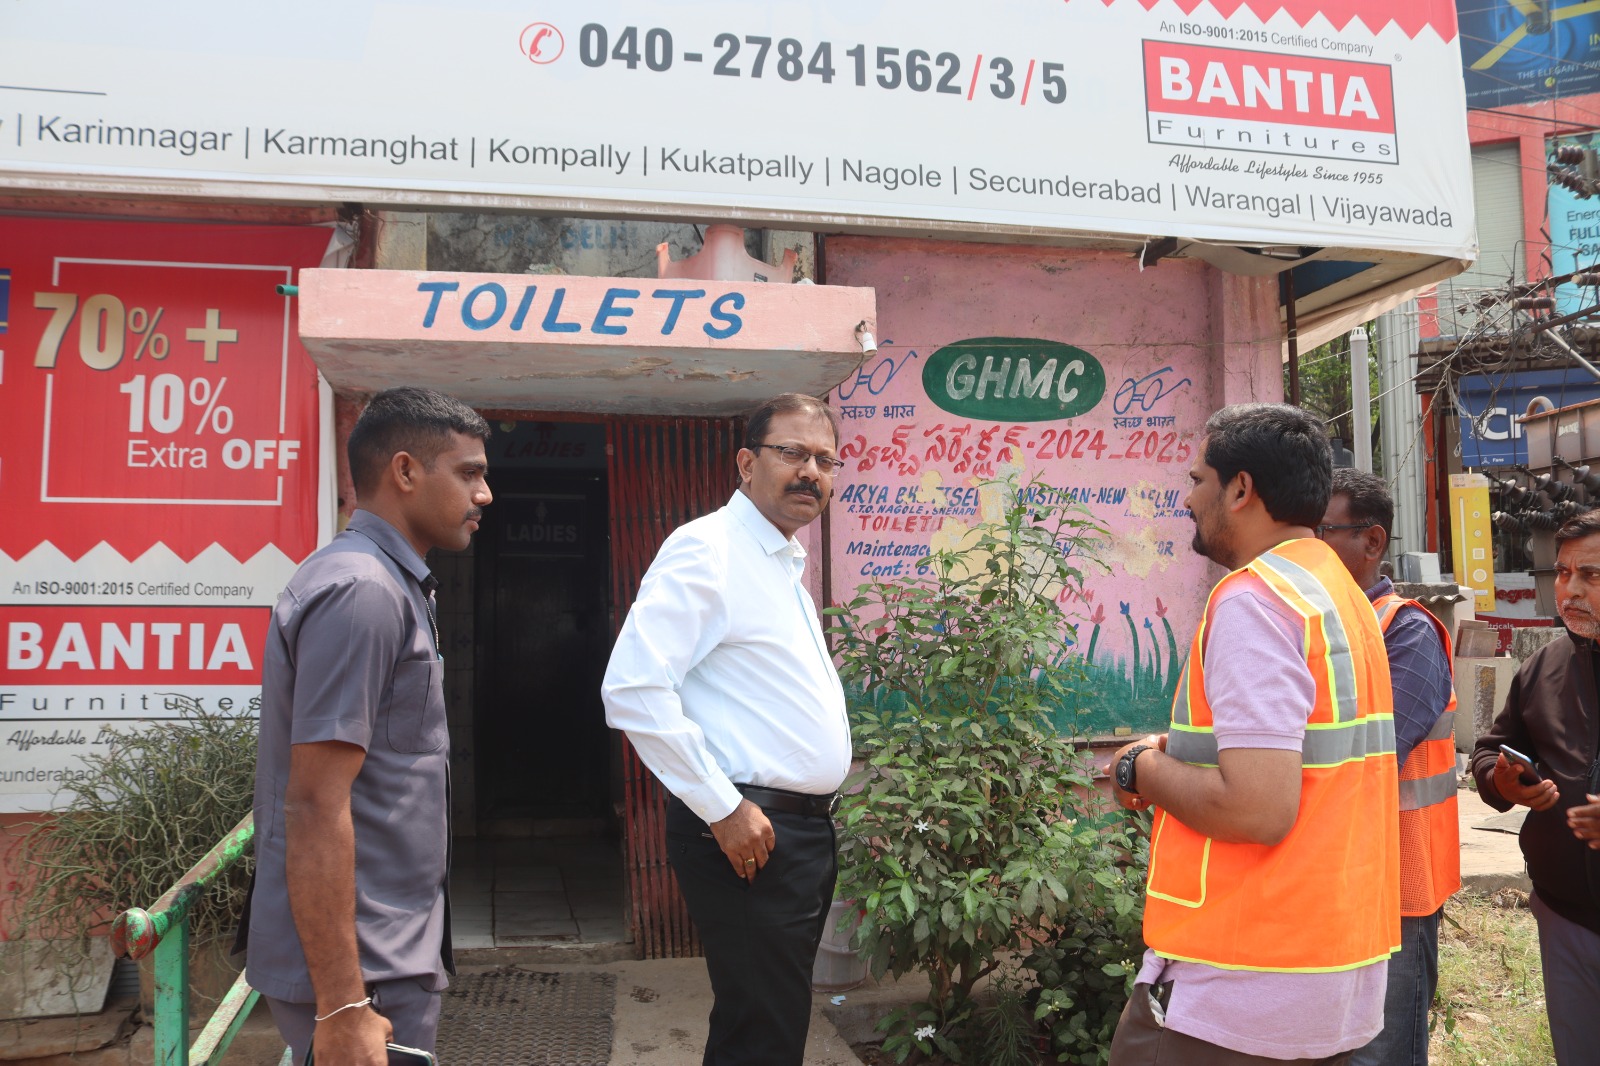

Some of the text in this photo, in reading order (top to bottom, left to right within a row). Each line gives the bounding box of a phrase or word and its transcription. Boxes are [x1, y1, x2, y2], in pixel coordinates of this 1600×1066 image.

[1159, 21, 1374, 56] An ISO-9001:2015 Certified Company
[1159, 56, 1380, 120] BANTIA
[1157, 119, 1391, 156] Furnitures
[37, 114, 1452, 228] Karimnagar Karmanghat Kompally Kukatpally Nagole Secunderabad Warangal Vijayawada
[1168, 154, 1384, 185] Affordable Lifestyles Since 1955
[417, 282, 746, 340] TOILETS
[33, 291, 170, 371] 70%
[945, 353, 1085, 403] GHMC
[120, 373, 234, 435] 10%
[883, 405, 916, 420] भारत
[1146, 415, 1176, 428] भारत
[127, 438, 300, 469] Extra OFF
[839, 483, 889, 504] ARYA
[931, 506, 978, 516] SNEHAPU
[1172, 509, 1193, 518] ROA
[506, 524, 577, 542] LADIES
[12, 581, 254, 599] An ISO-9001:2015 Certified Company
[1488, 622, 1515, 630] tricals
[7, 621, 254, 671] BANTIA
[0, 693, 262, 711] Furnitures
[6, 729, 87, 751] Affordable
